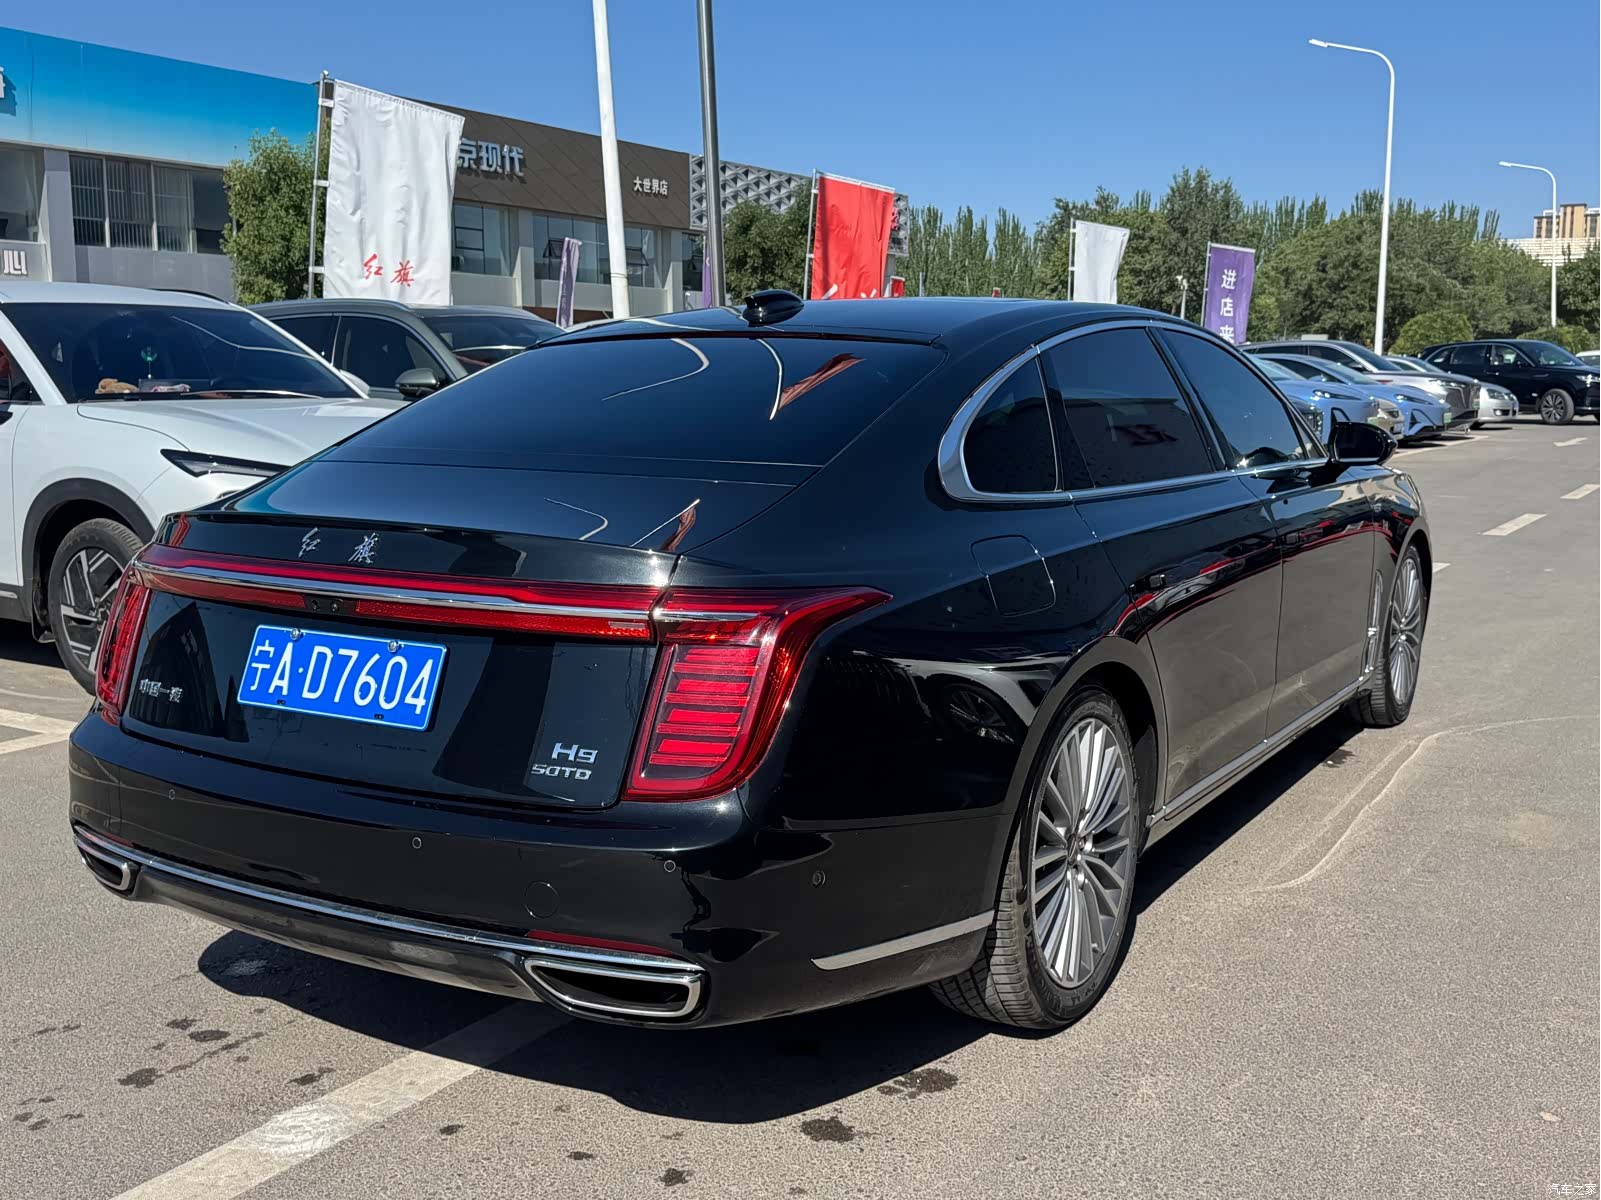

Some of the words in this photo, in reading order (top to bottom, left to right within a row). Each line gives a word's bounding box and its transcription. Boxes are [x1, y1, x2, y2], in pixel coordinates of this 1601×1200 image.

[457, 137, 524, 176] 京现代
[633, 176, 668, 196] 大世界店
[363, 253, 414, 288] 红旗
[1220, 268, 1237, 344] 进店来
[298, 527, 378, 564] 红旗
[551, 742, 598, 764] H9
[530, 763, 592, 780] 50TD
